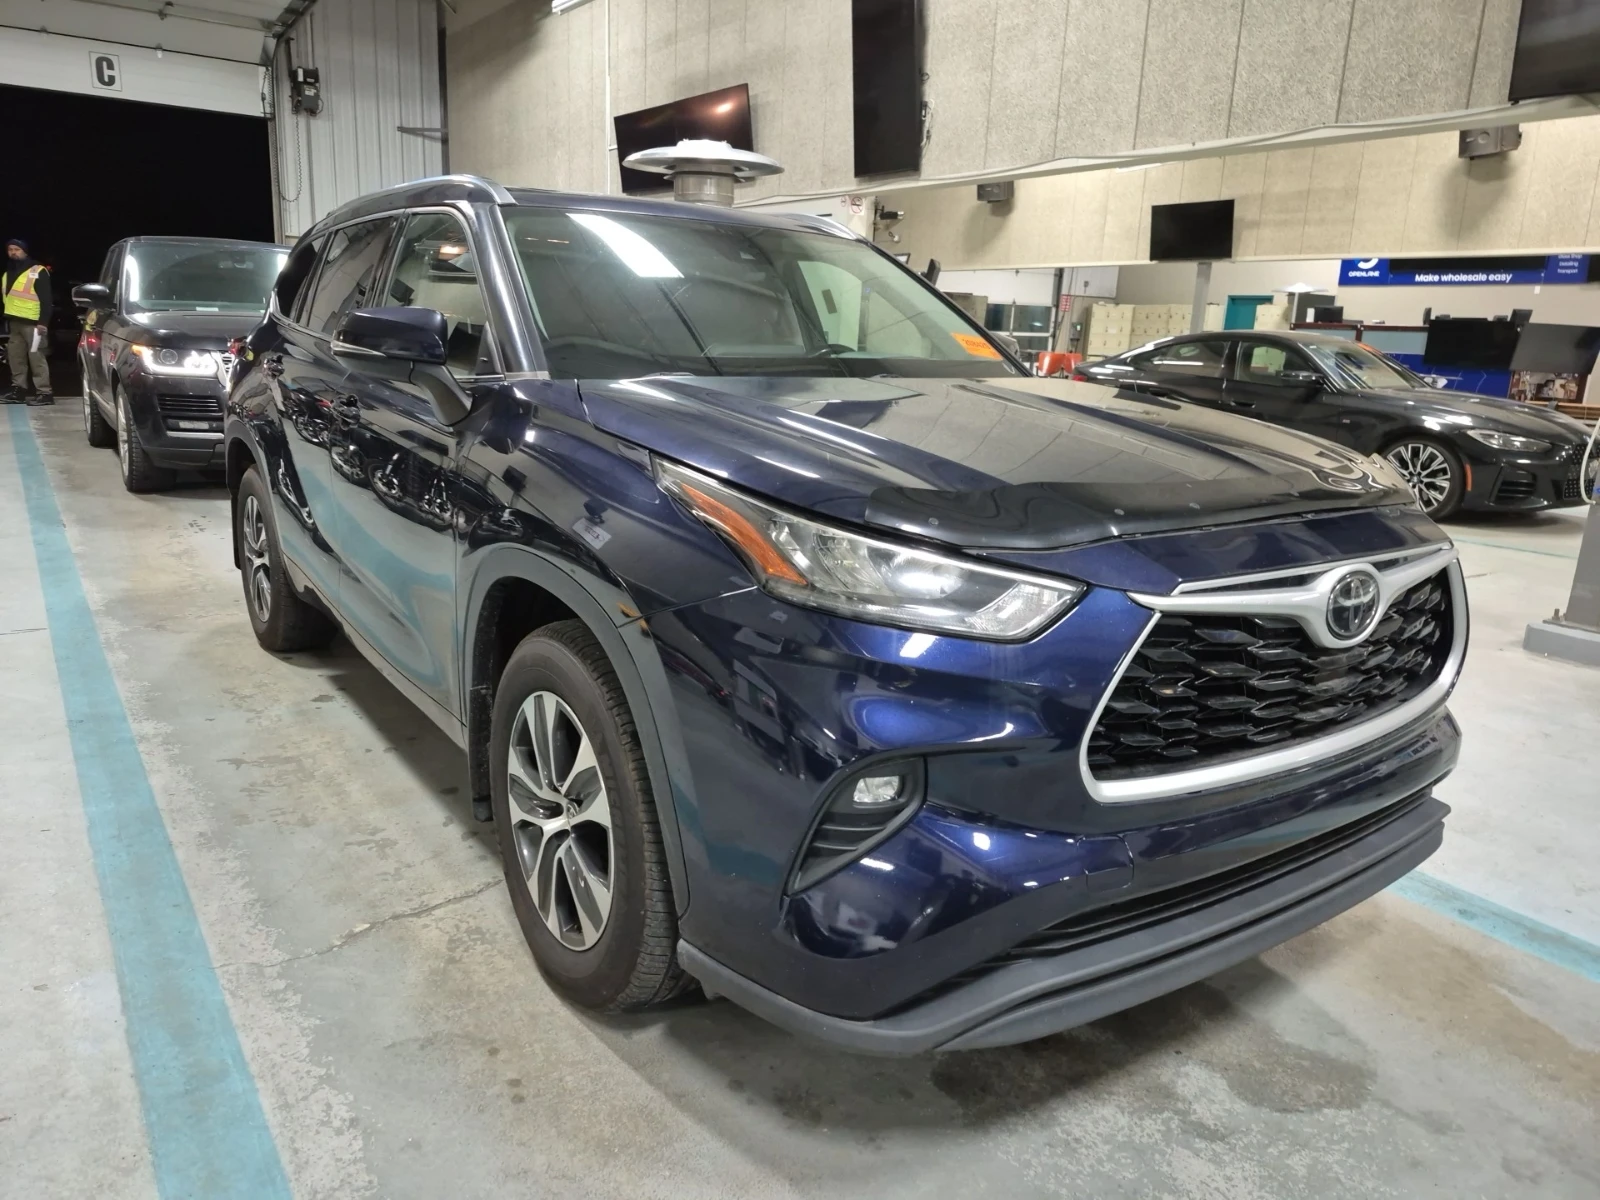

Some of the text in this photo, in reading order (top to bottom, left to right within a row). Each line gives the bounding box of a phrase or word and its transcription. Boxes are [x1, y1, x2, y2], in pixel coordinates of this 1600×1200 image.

[95, 56, 116, 87] C
[1348, 270, 1380, 278] OPENLANE
[1414, 272, 1513, 284] Make wholesale easy
